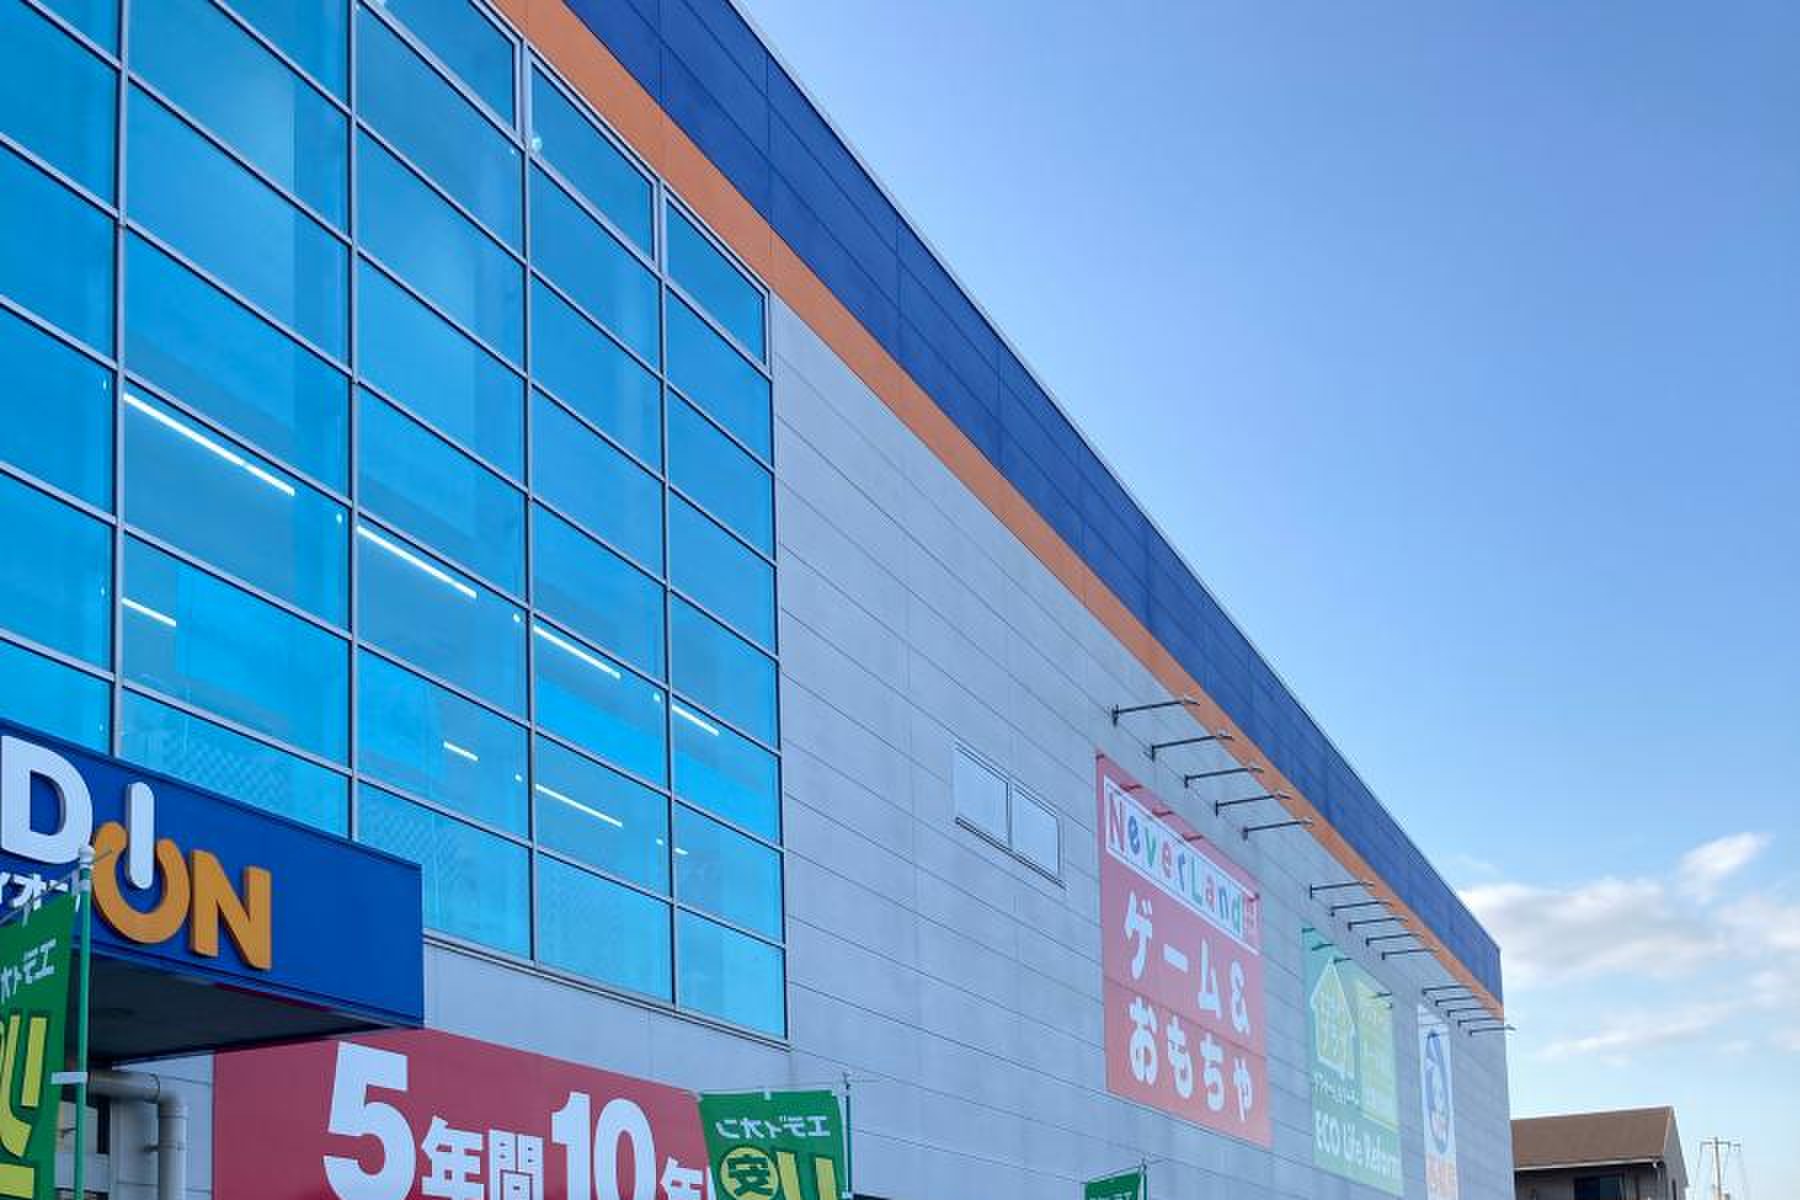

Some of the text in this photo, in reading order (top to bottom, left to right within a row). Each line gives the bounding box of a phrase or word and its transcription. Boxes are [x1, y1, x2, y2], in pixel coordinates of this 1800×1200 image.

[1108, 792, 1243, 938] NeverLand
[1128, 996, 1253, 1121] おもちゃ
